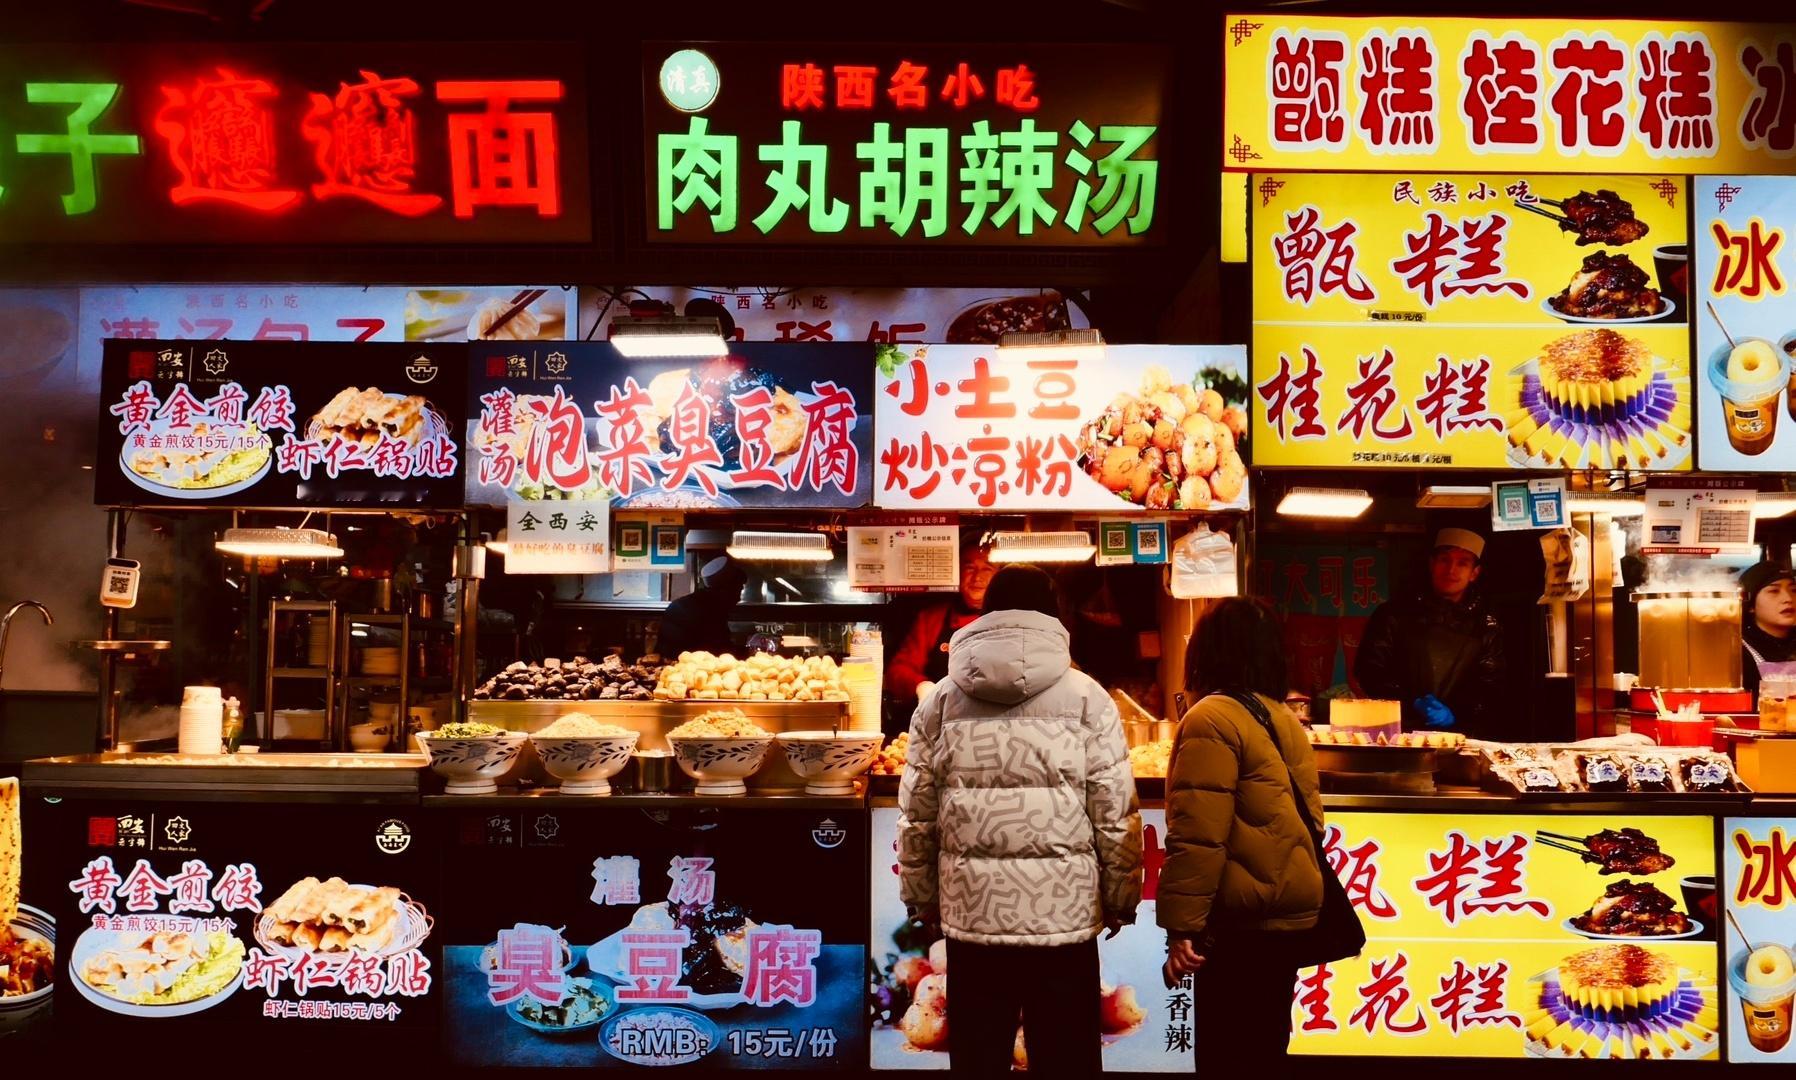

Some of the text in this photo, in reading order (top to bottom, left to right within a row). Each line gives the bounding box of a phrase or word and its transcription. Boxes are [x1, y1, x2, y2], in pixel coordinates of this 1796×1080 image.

[666, 64, 710, 95] 清真
[781, 61, 1040, 109] 陕西名小吃
[1270, 33, 1437, 148] 甑糕
[1462, 36, 1717, 151] 桂花糕
[0, 81, 142, 216] 子
[656, 115, 1159, 238] 肉丸胡辣汤
[1391, 179, 1541, 206] 民族小吃
[1270, 206, 1533, 308] 甑糕
[711, 295, 829, 311] 陕西名小吃
[110, 380, 296, 434] 黄金煎饺
[883, 356, 1081, 420] 小土豆
[1256, 344, 1507, 442] 桂花糕
[131, 433, 270, 451] 黄金煎饺15元/15个
[276, 435, 458, 479] 虾仁锅贴
[479, 388, 517, 488] 灌汤
[523, 376, 860, 498] 泡菜臭豆腐
[879, 423, 1079, 508] 炒凉粉
[517, 510, 599, 532] 全西安
[68, 855, 263, 914] 黄金煎饺
[590, 854, 717, 906] 灌汤
[92, 914, 237, 936] 黄金煎饺15元/15个
[242, 947, 432, 998] 虾仁锅贴
[488, 925, 822, 1008] 臭豆腐
[263, 999, 402, 1021] 虾仁锅贴15元/5个
[726, 1027, 839, 1059] 15元/份
